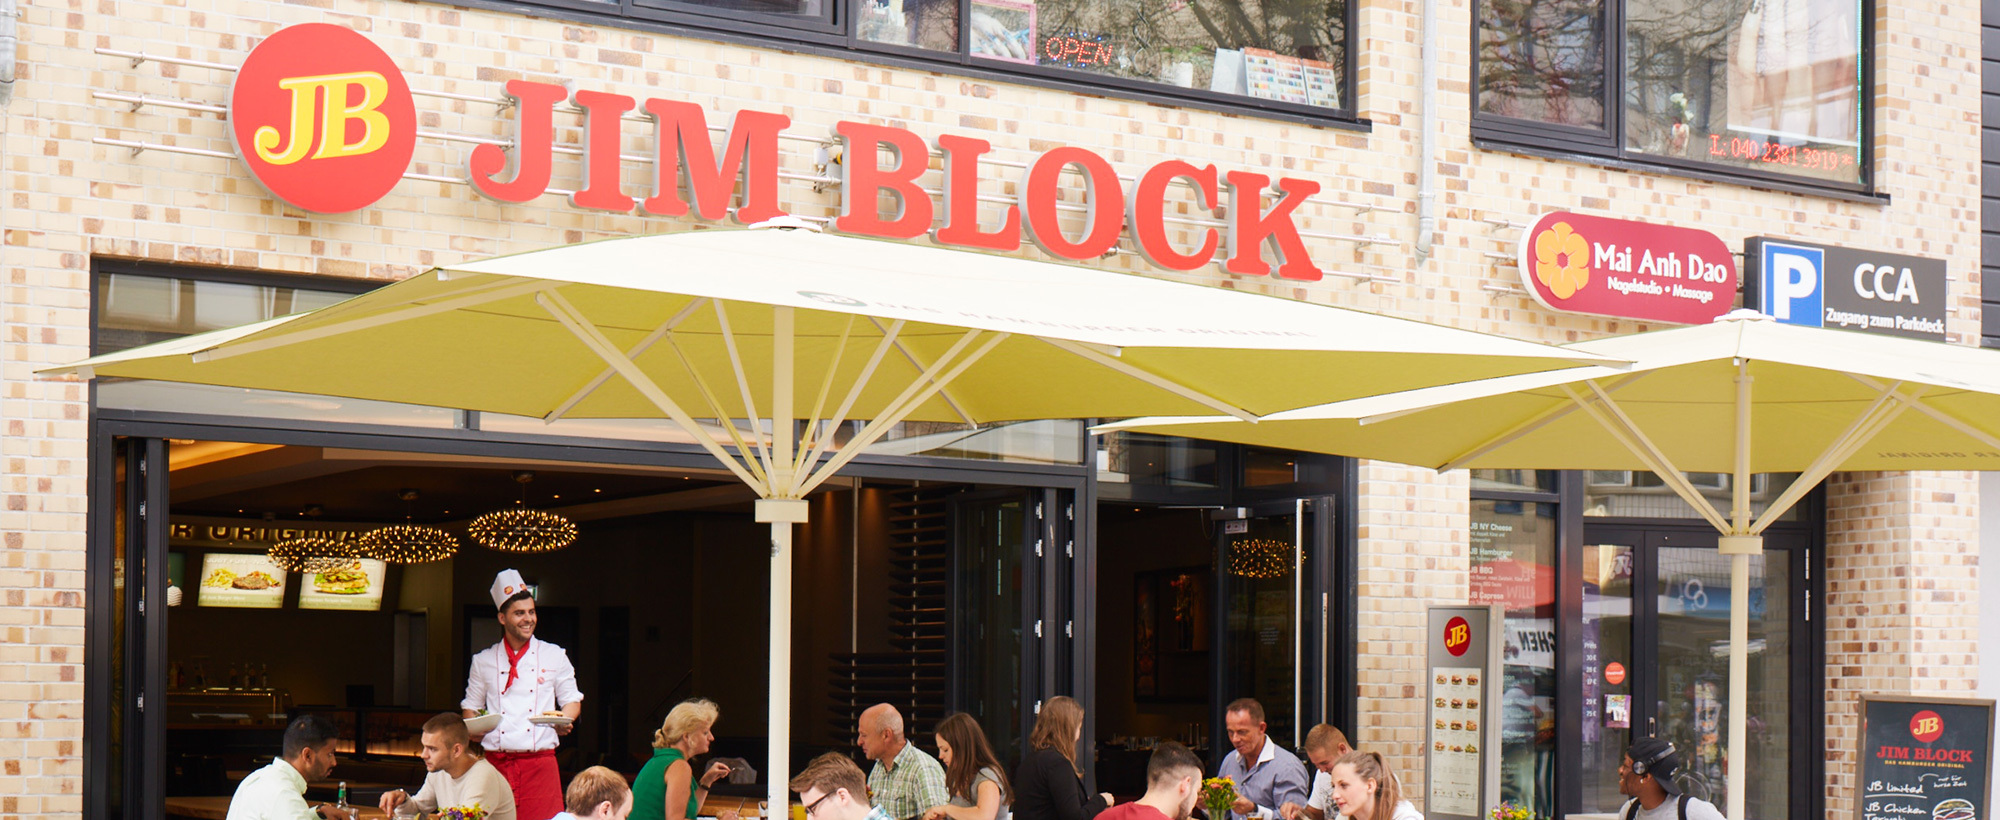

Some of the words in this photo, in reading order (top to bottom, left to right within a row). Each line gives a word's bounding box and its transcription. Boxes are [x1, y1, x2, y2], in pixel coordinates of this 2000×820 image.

[1046, 37, 1113, 66] OPEN
[253, 71, 390, 165] JB
[1731, 137, 1759, 160] 040
[1762, 142, 1797, 167] 2381
[1802, 148, 1839, 171] 3919
[469, 79, 791, 224] JIM
[830, 120, 1323, 282] BLOCK
[1593, 242, 1632, 272] Mai
[1638, 248, 1681, 278] Anh
[1688, 253, 1727, 283] Dao
[1607, 276, 1663, 295] Nagelstudio
[1672, 284, 1713, 304] Massage
[1773, 253, 1817, 320] P
[1853, 262, 1919, 304] CCA
[1826, 307, 1869, 329] Zugang
[1870, 315, 1894, 329] zum
[1895, 315, 1945, 335] Parkdeck
[1470, 522, 1478, 531] JB
[1479, 523, 1489, 531] NY
[1490, 523, 1512, 532] Cheese
[1470, 547, 1478, 556] JB
[1480, 548, 1513, 558] Hamburger
[1470, 566, 1478, 574] JB
[1479, 566, 1493, 574] BBQ
[1470, 590, 1478, 599] JB
[1479, 591, 1504, 600] Caprese
[1446, 624, 1467, 648] JB
[1913, 717, 1939, 735] JB
[1876, 745, 1909, 759] JIM
[1914, 747, 1973, 763] BLOCK
[1867, 780, 1883, 792] JB
[1865, 801, 1880, 812] JB
[1884, 803, 1927, 815] Chicken
